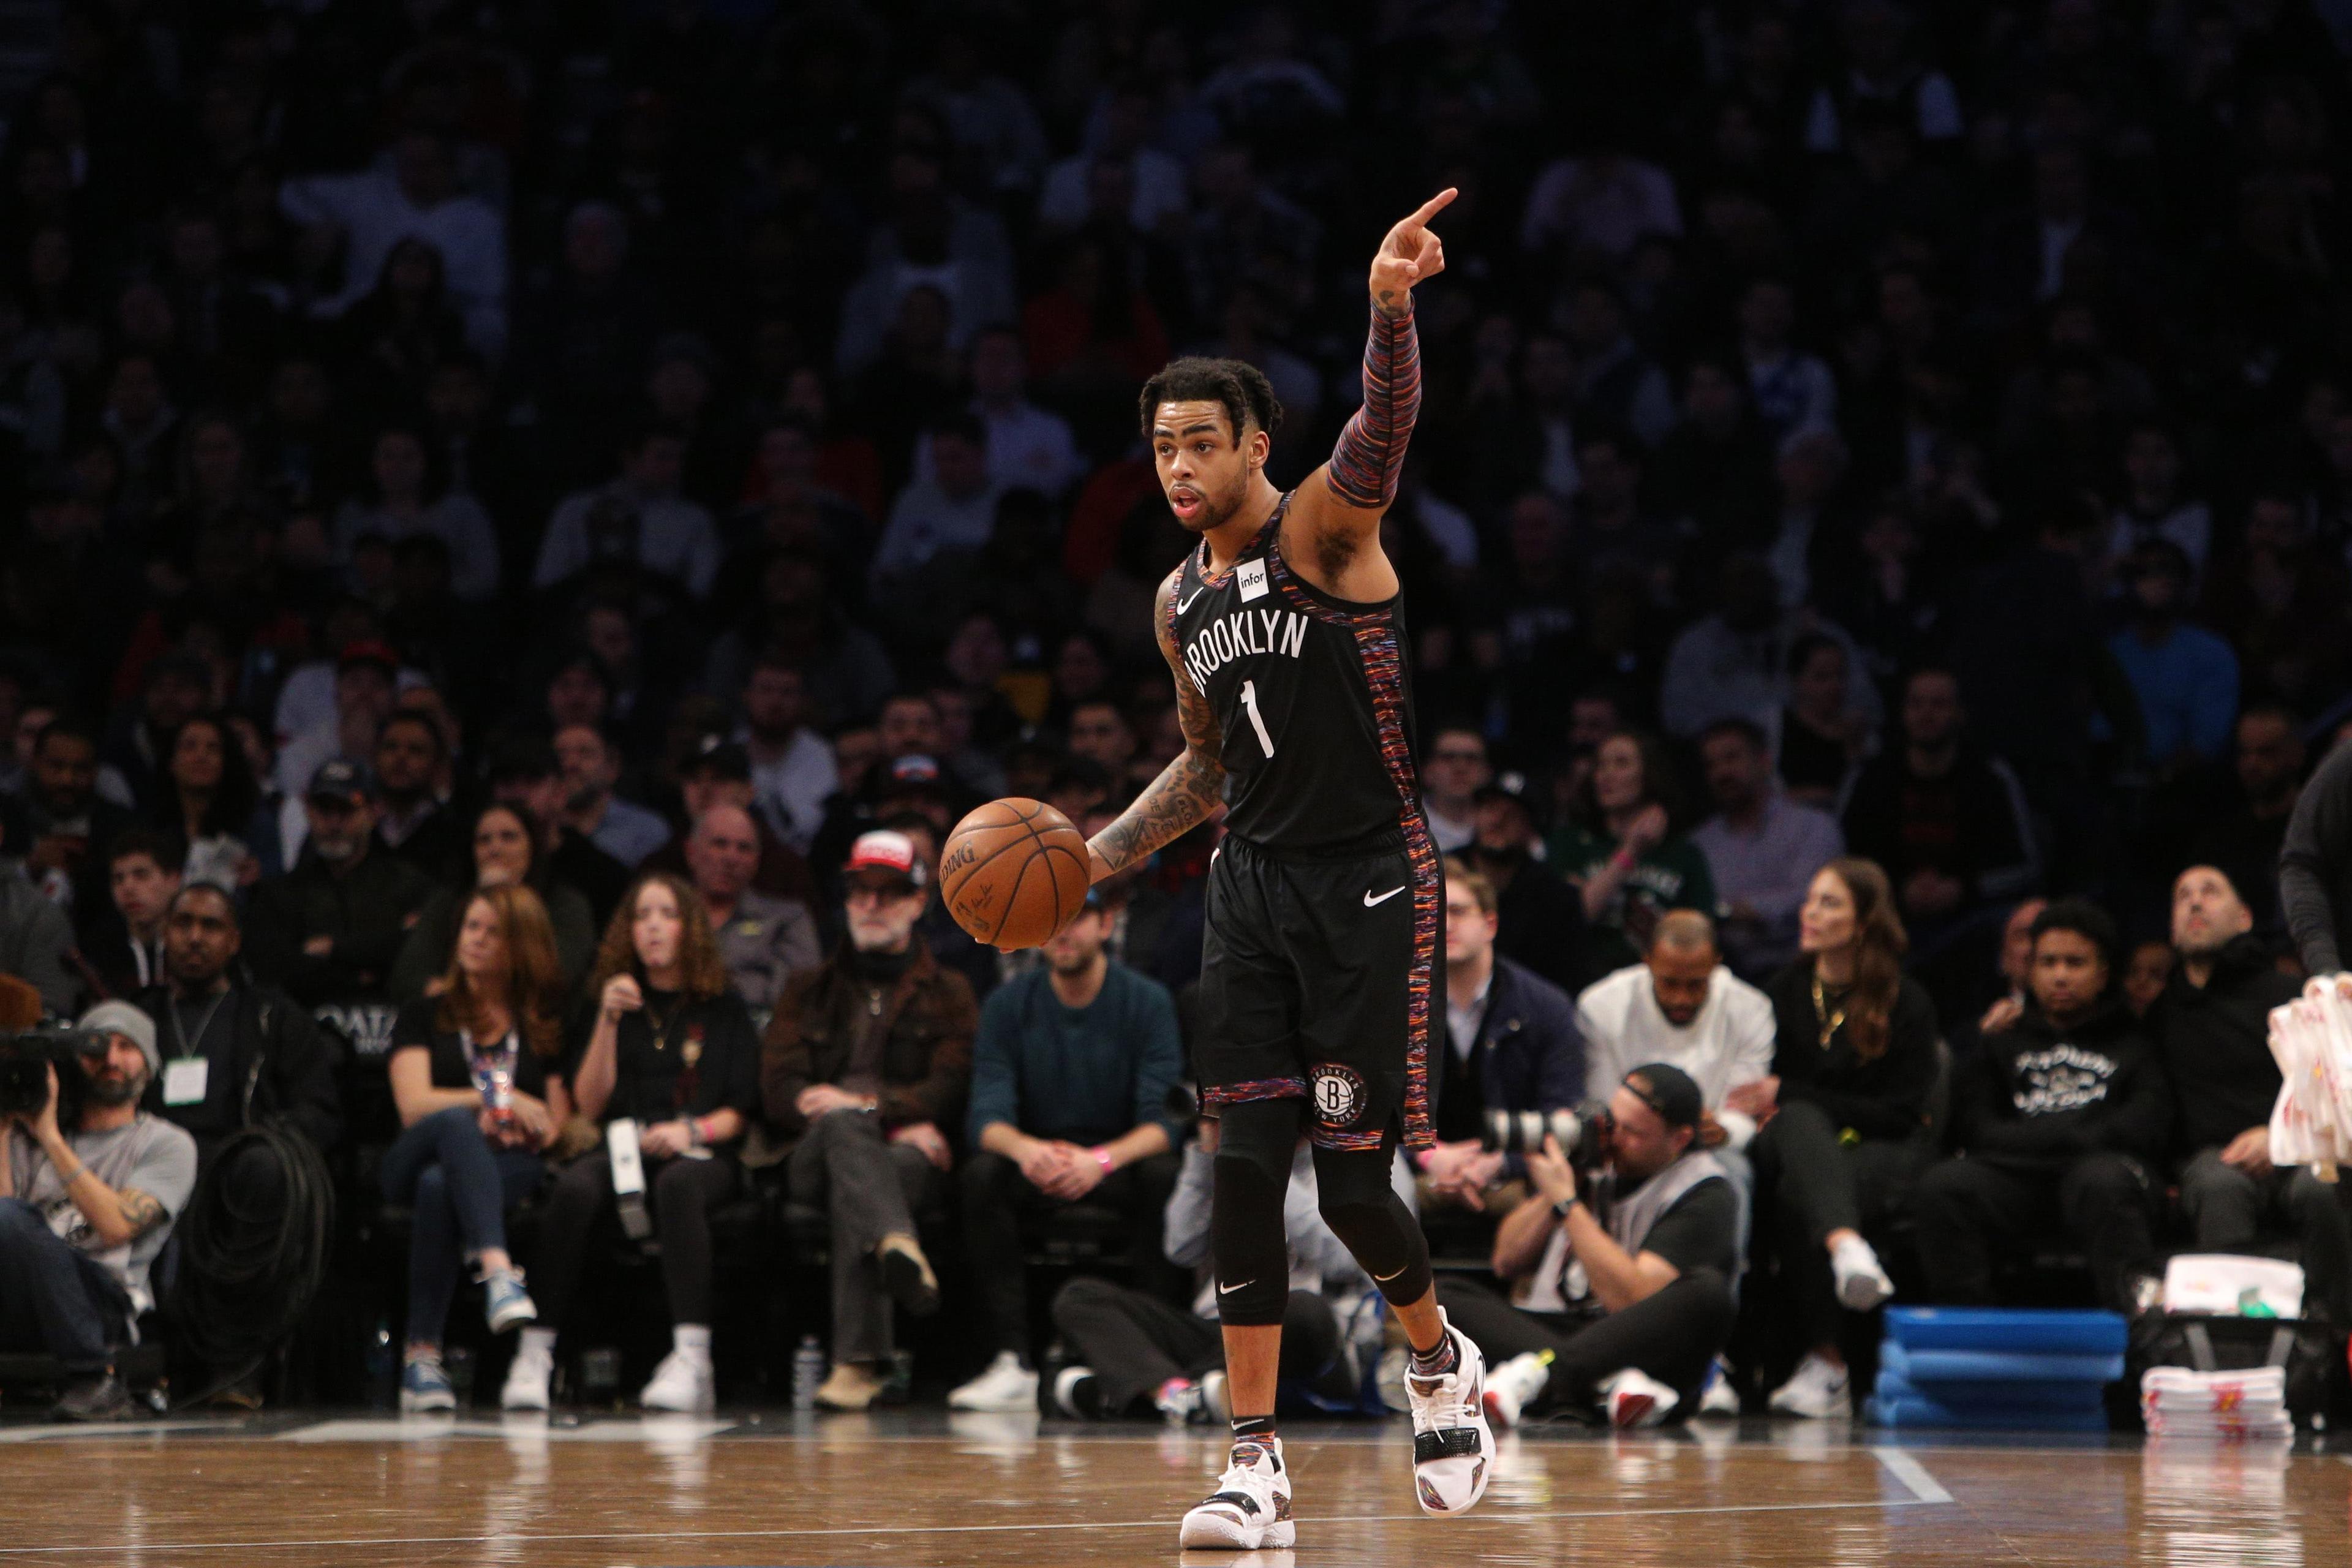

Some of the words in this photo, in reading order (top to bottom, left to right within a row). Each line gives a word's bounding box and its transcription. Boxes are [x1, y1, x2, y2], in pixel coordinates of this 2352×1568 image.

[1240, 573, 1264, 589] infor
[1240, 680, 1275, 758] 1
[940, 840, 975, 882] DING
[1312, 1068, 1359, 1089] BROOKLYN
[1327, 1080, 1340, 1110] B
[1333, 1108, 1357, 1123] YORK
